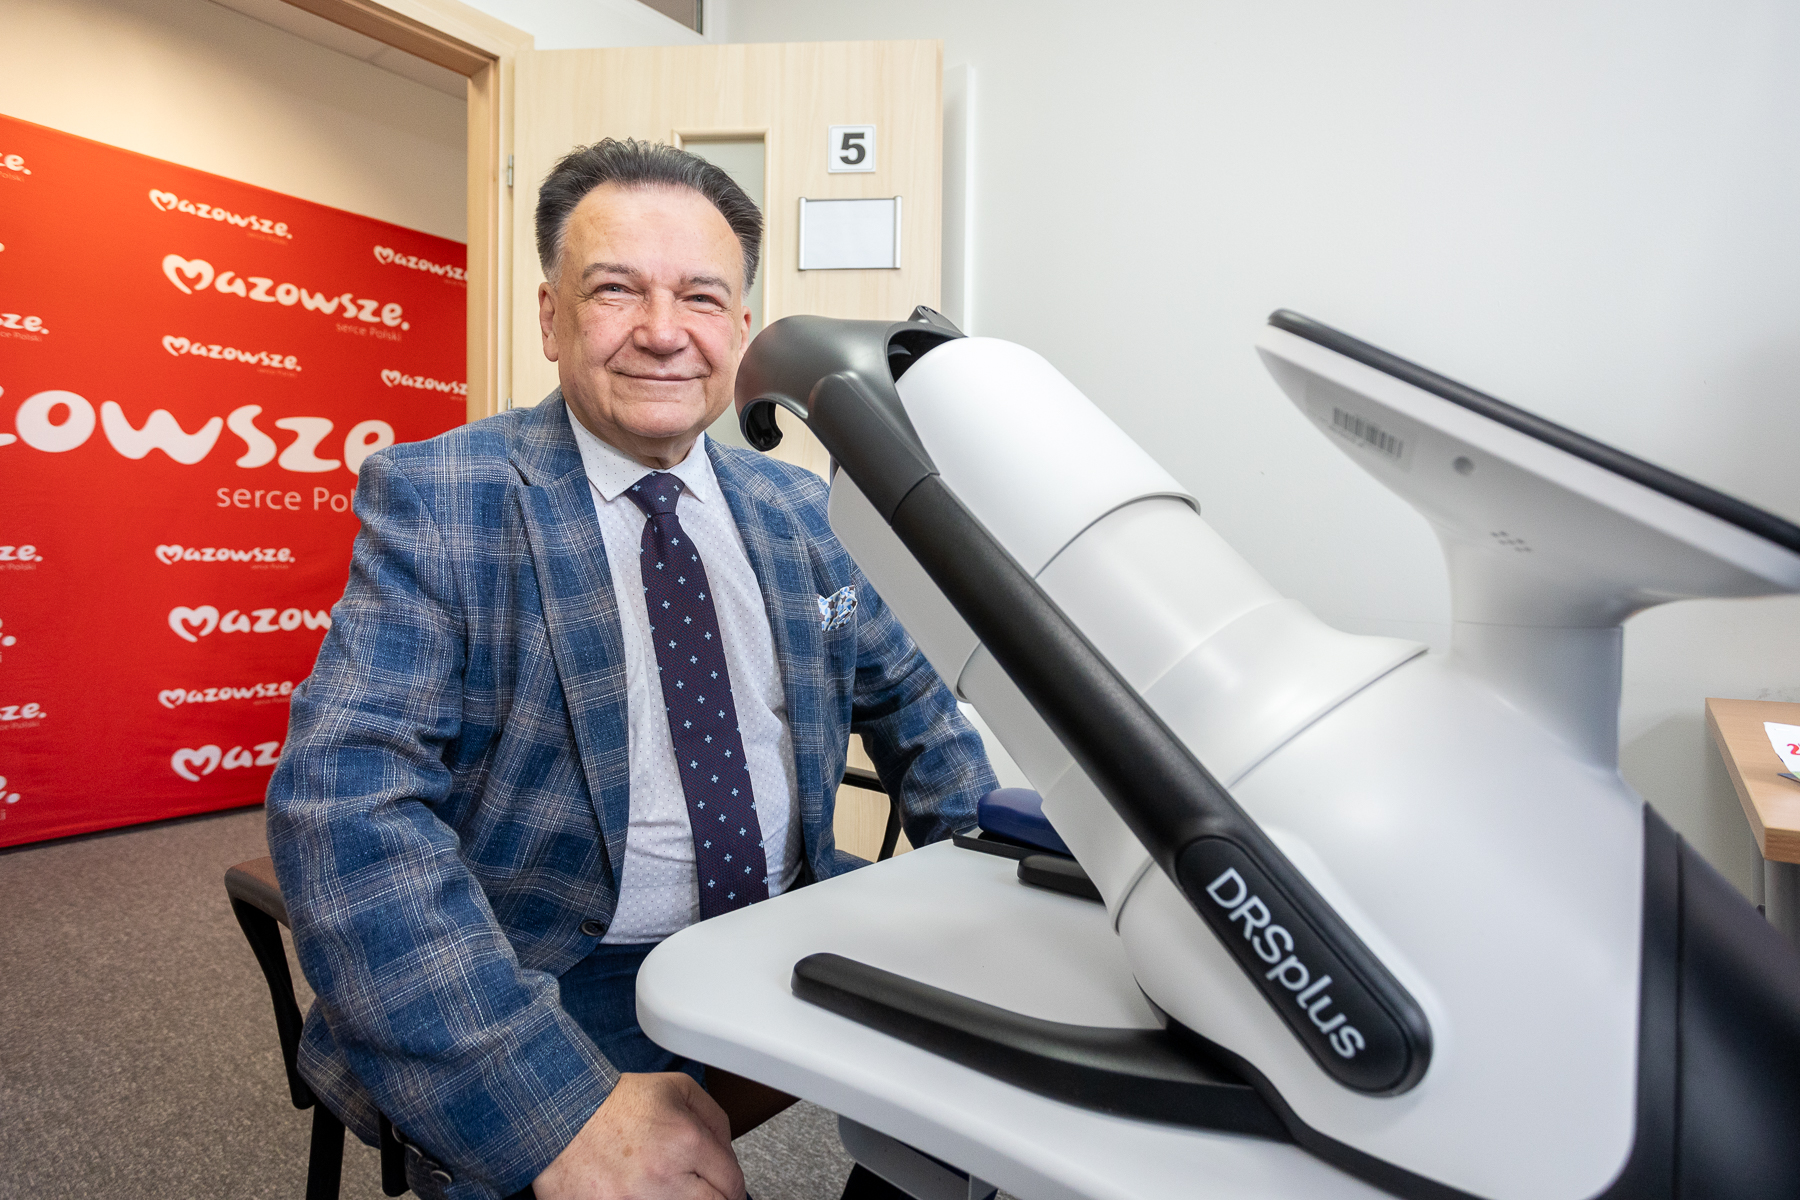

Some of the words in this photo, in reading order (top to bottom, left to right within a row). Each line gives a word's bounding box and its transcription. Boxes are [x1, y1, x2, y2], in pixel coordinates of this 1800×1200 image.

[839, 131, 867, 166] 5
[216, 487, 302, 511] serce
[158, 680, 293, 709] Mazowsze
[1205, 867, 1366, 1060] DRSplus
